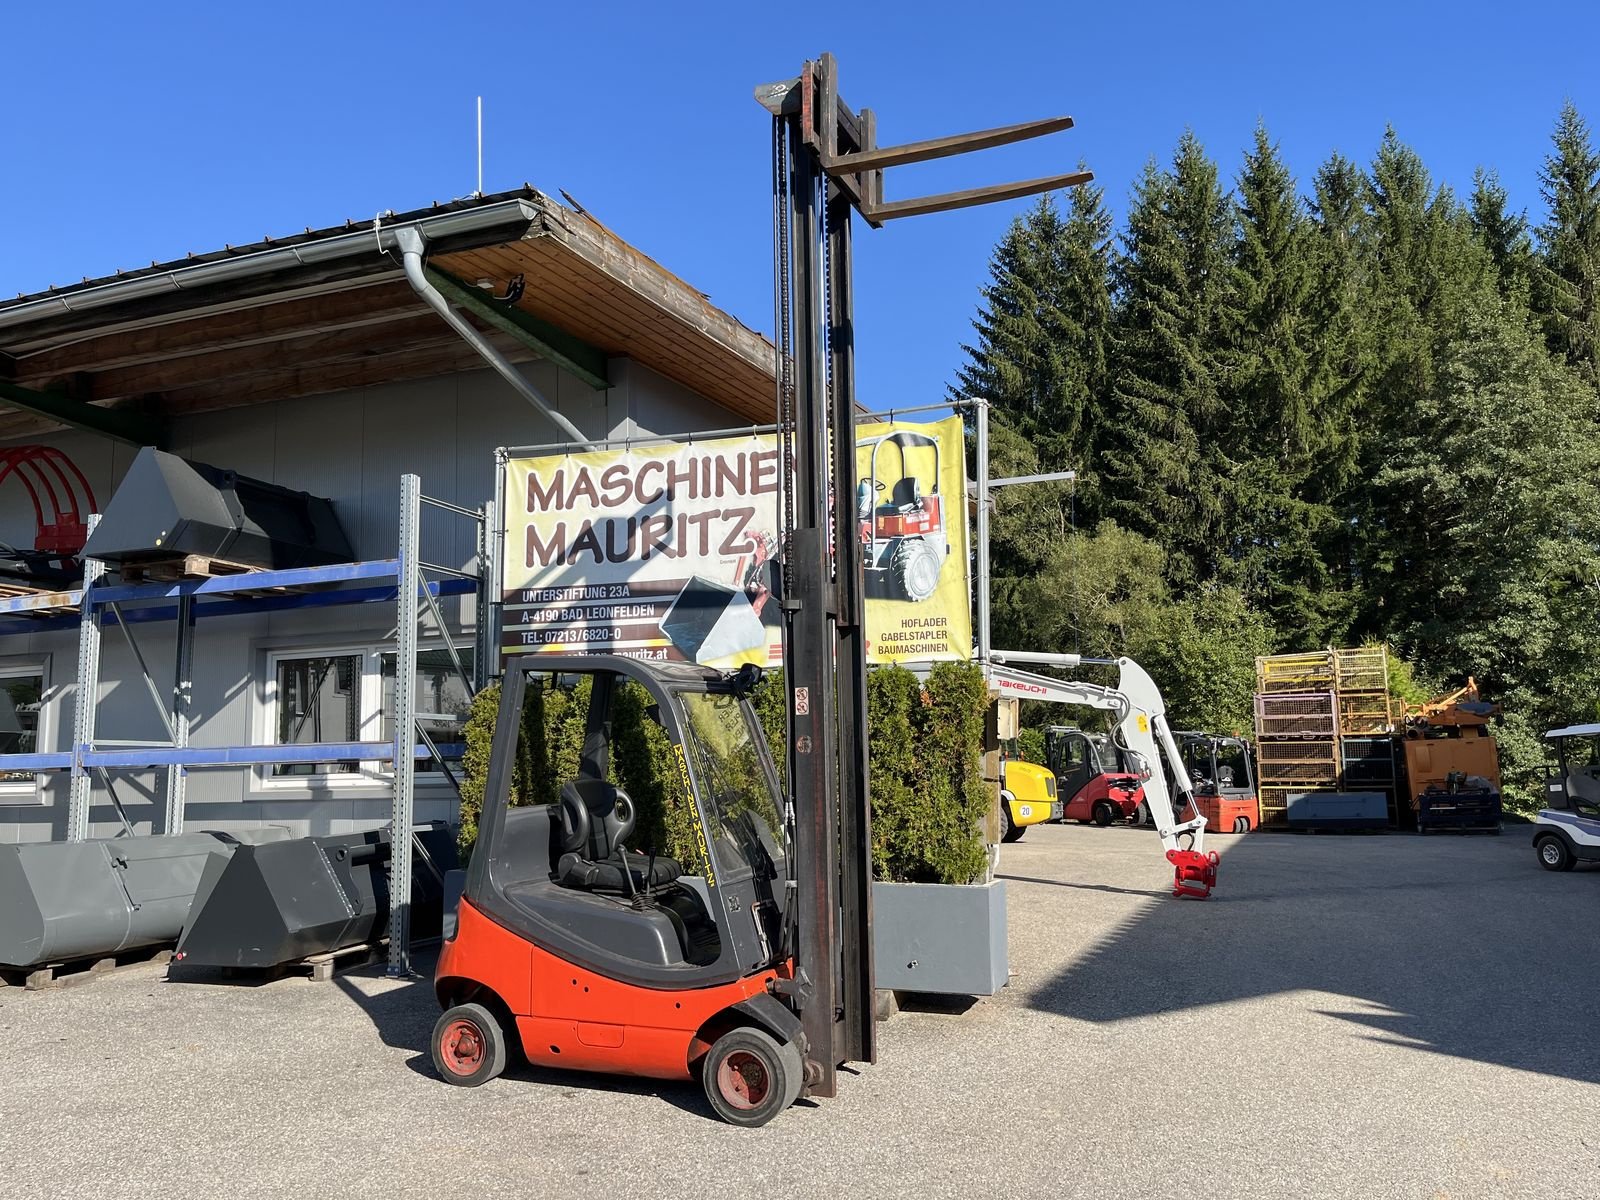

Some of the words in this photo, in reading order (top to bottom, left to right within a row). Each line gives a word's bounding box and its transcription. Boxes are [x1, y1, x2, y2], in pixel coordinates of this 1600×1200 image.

[526, 449, 797, 513] MASCHINE
[525, 505, 756, 568] MAURITZ
[522, 586, 607, 603] UNTERSTIFTUNG
[609, 585, 631, 598] 23A
[521, 609, 559, 623] A-4190
[561, 608, 583, 621] BAD
[586, 604, 655, 620] LEONFELDEN
[901, 617, 947, 629] HOFLADER
[521, 631, 543, 644] TEL:
[544, 627, 622, 643] 07213/6820-0
[881, 630, 948, 642] GABELSTAPLER
[878, 643, 948, 655] BAUMASCHINEN
[1021, 806, 1030, 816] 20
